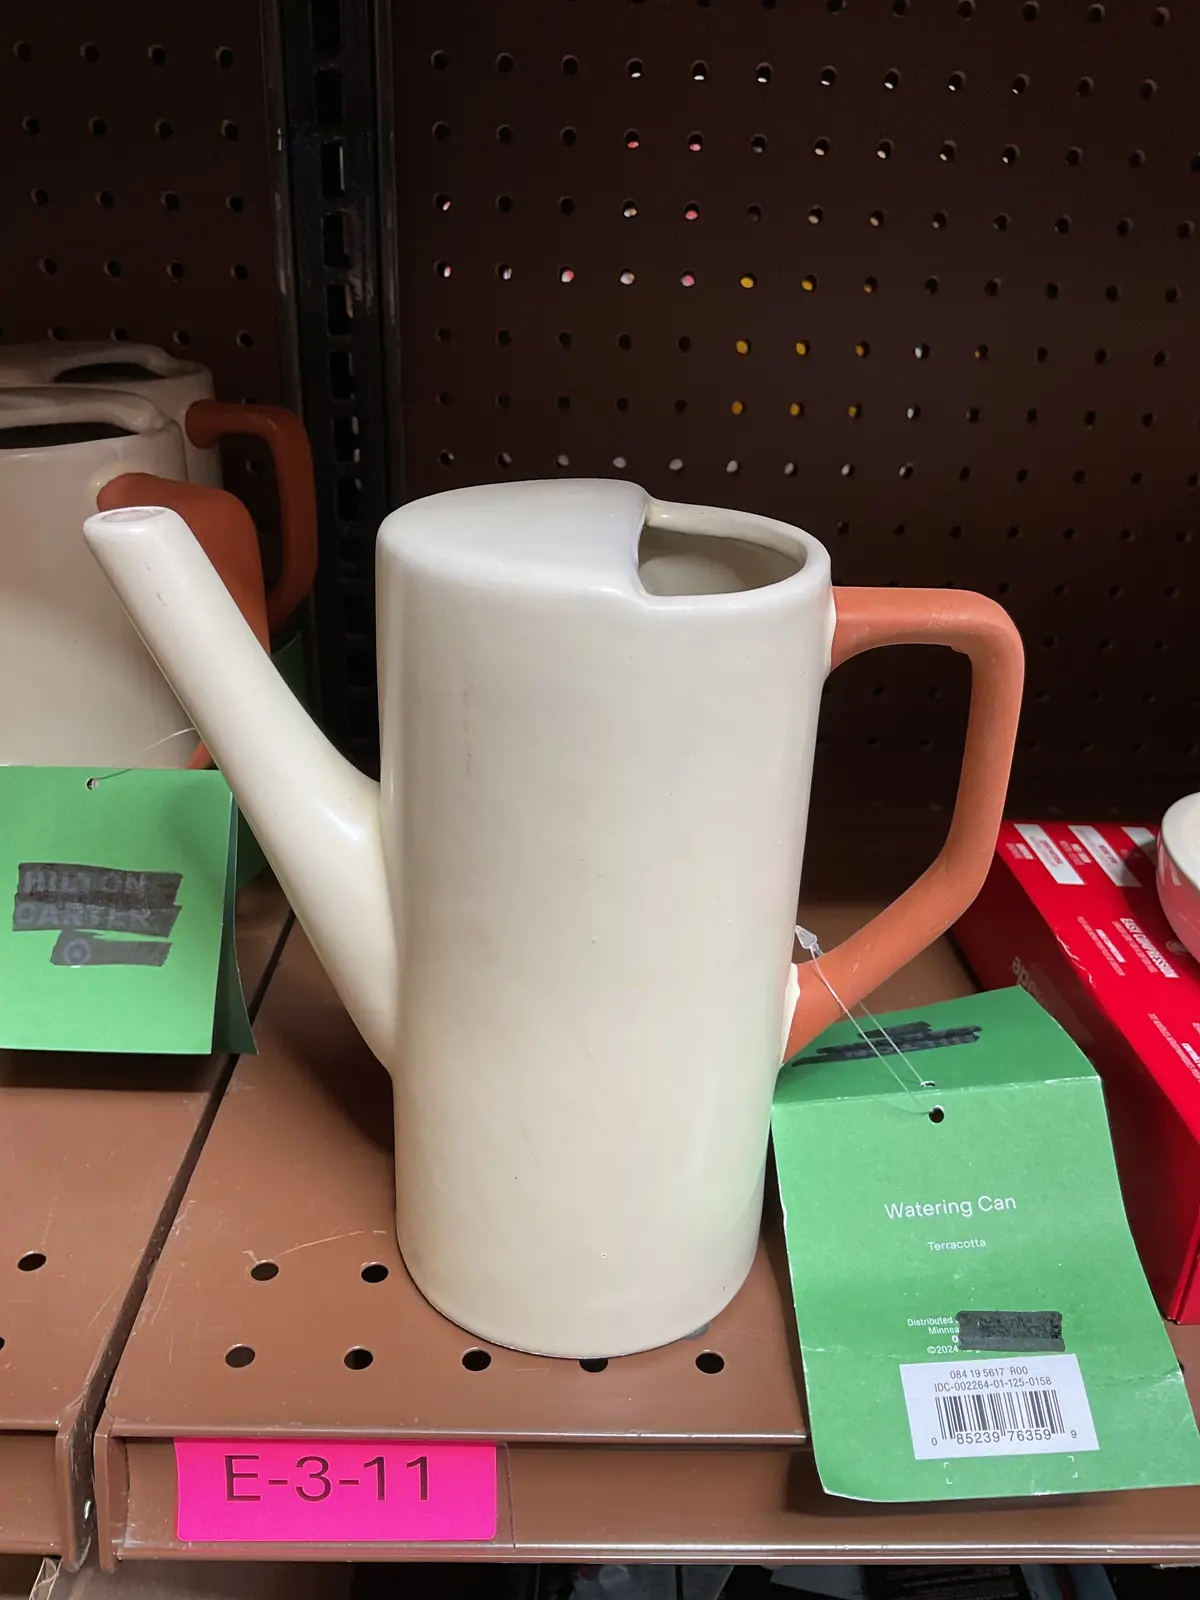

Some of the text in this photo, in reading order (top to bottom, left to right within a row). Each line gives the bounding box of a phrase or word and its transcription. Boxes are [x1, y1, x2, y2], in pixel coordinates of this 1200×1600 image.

[1120, 918, 1145, 933] EASY
[884, 1195, 1017, 1219] Watering Can
[927, 1238, 987, 1251] Terracotta
[906, 1316, 954, 1327] Distributed
[949, 1369, 968, 1380] 084
[970, 1368, 981, 1378] 19
[983, 1367, 1005, 1377] 5617
[934, 1377, 1052, 1393] IDC-002264-01-125-0158
[931, 1429, 1078, 1447] 0 85239 76359 9
[224, 1454, 428, 1501] E-3-11
